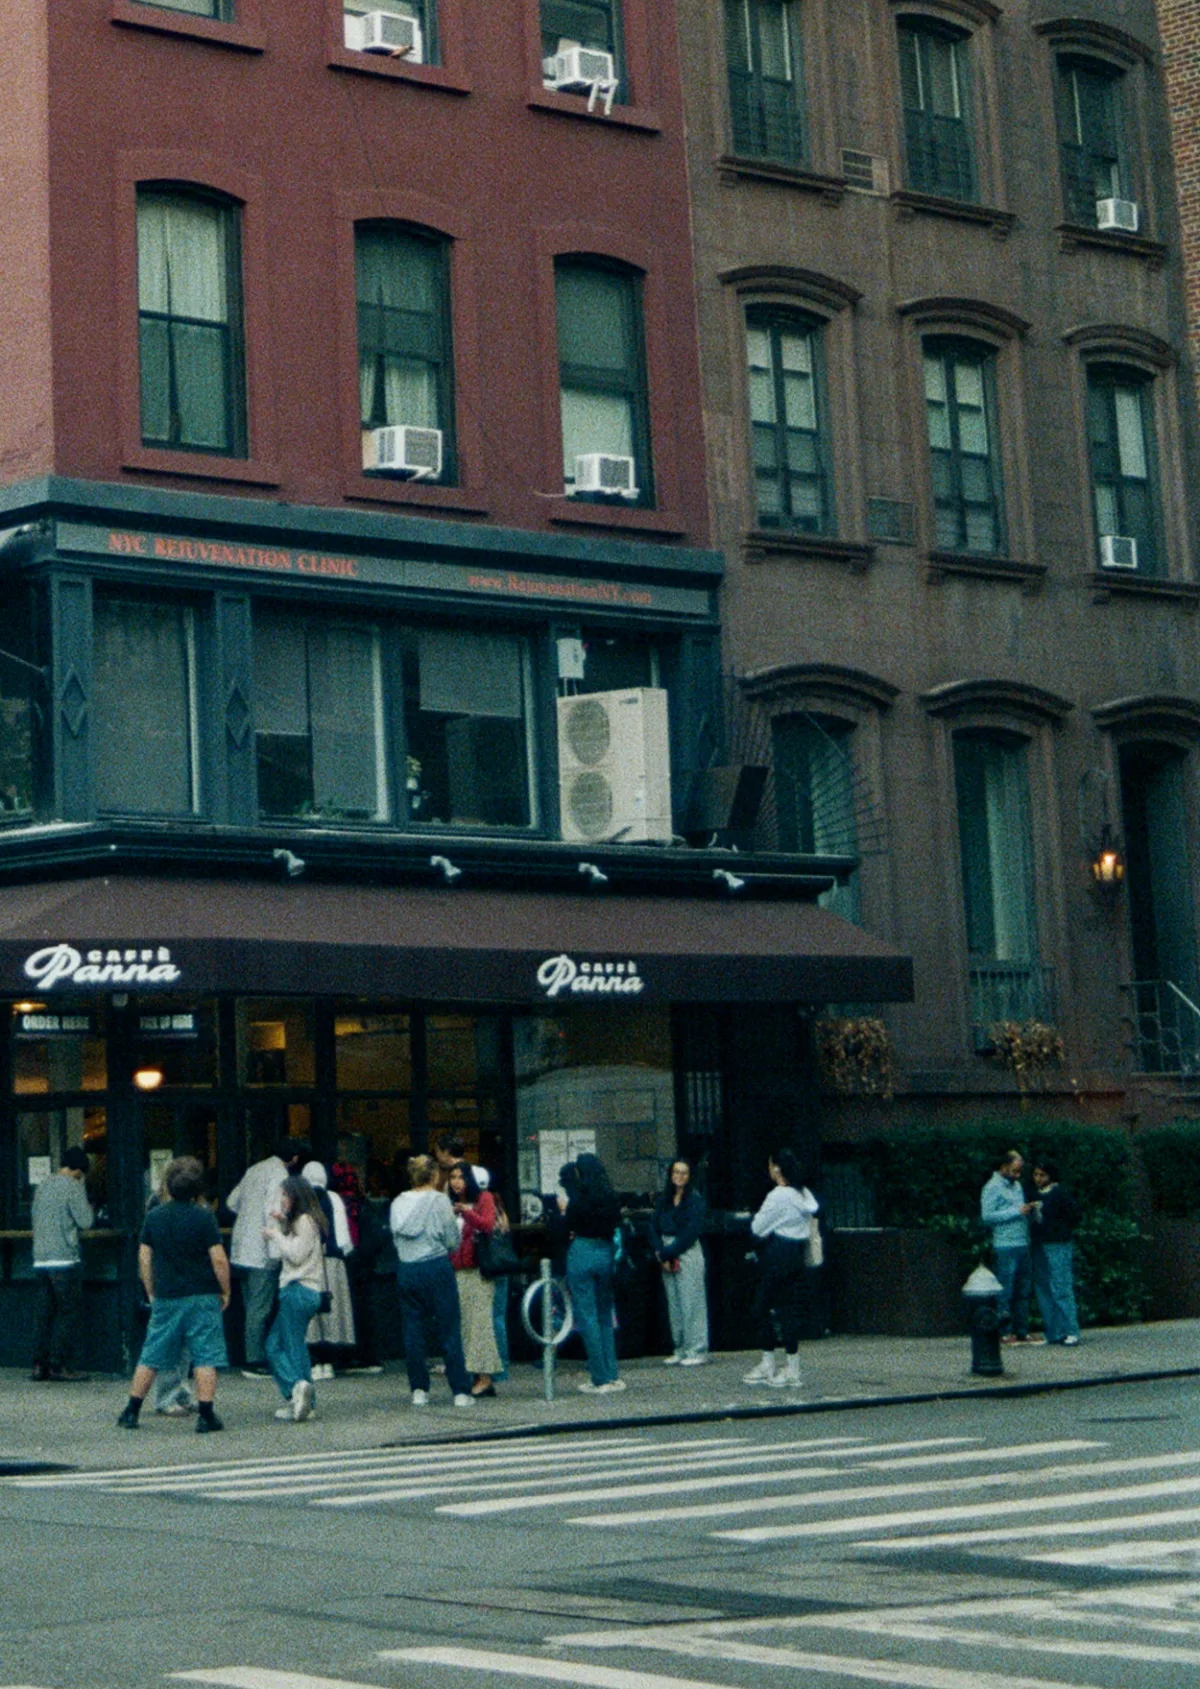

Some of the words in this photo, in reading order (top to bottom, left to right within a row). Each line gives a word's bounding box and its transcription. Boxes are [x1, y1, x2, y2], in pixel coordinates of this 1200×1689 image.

[108, 532, 147, 554] NYC
[154, 537, 291, 569] REJUVENATION
[297, 553, 360, 576] CLINIC
[24, 943, 181, 990] Panna
[86, 945, 171, 963] CAFFÈ
[537, 954, 644, 996] Panna
[22, 1014, 60, 1030] ORDER
